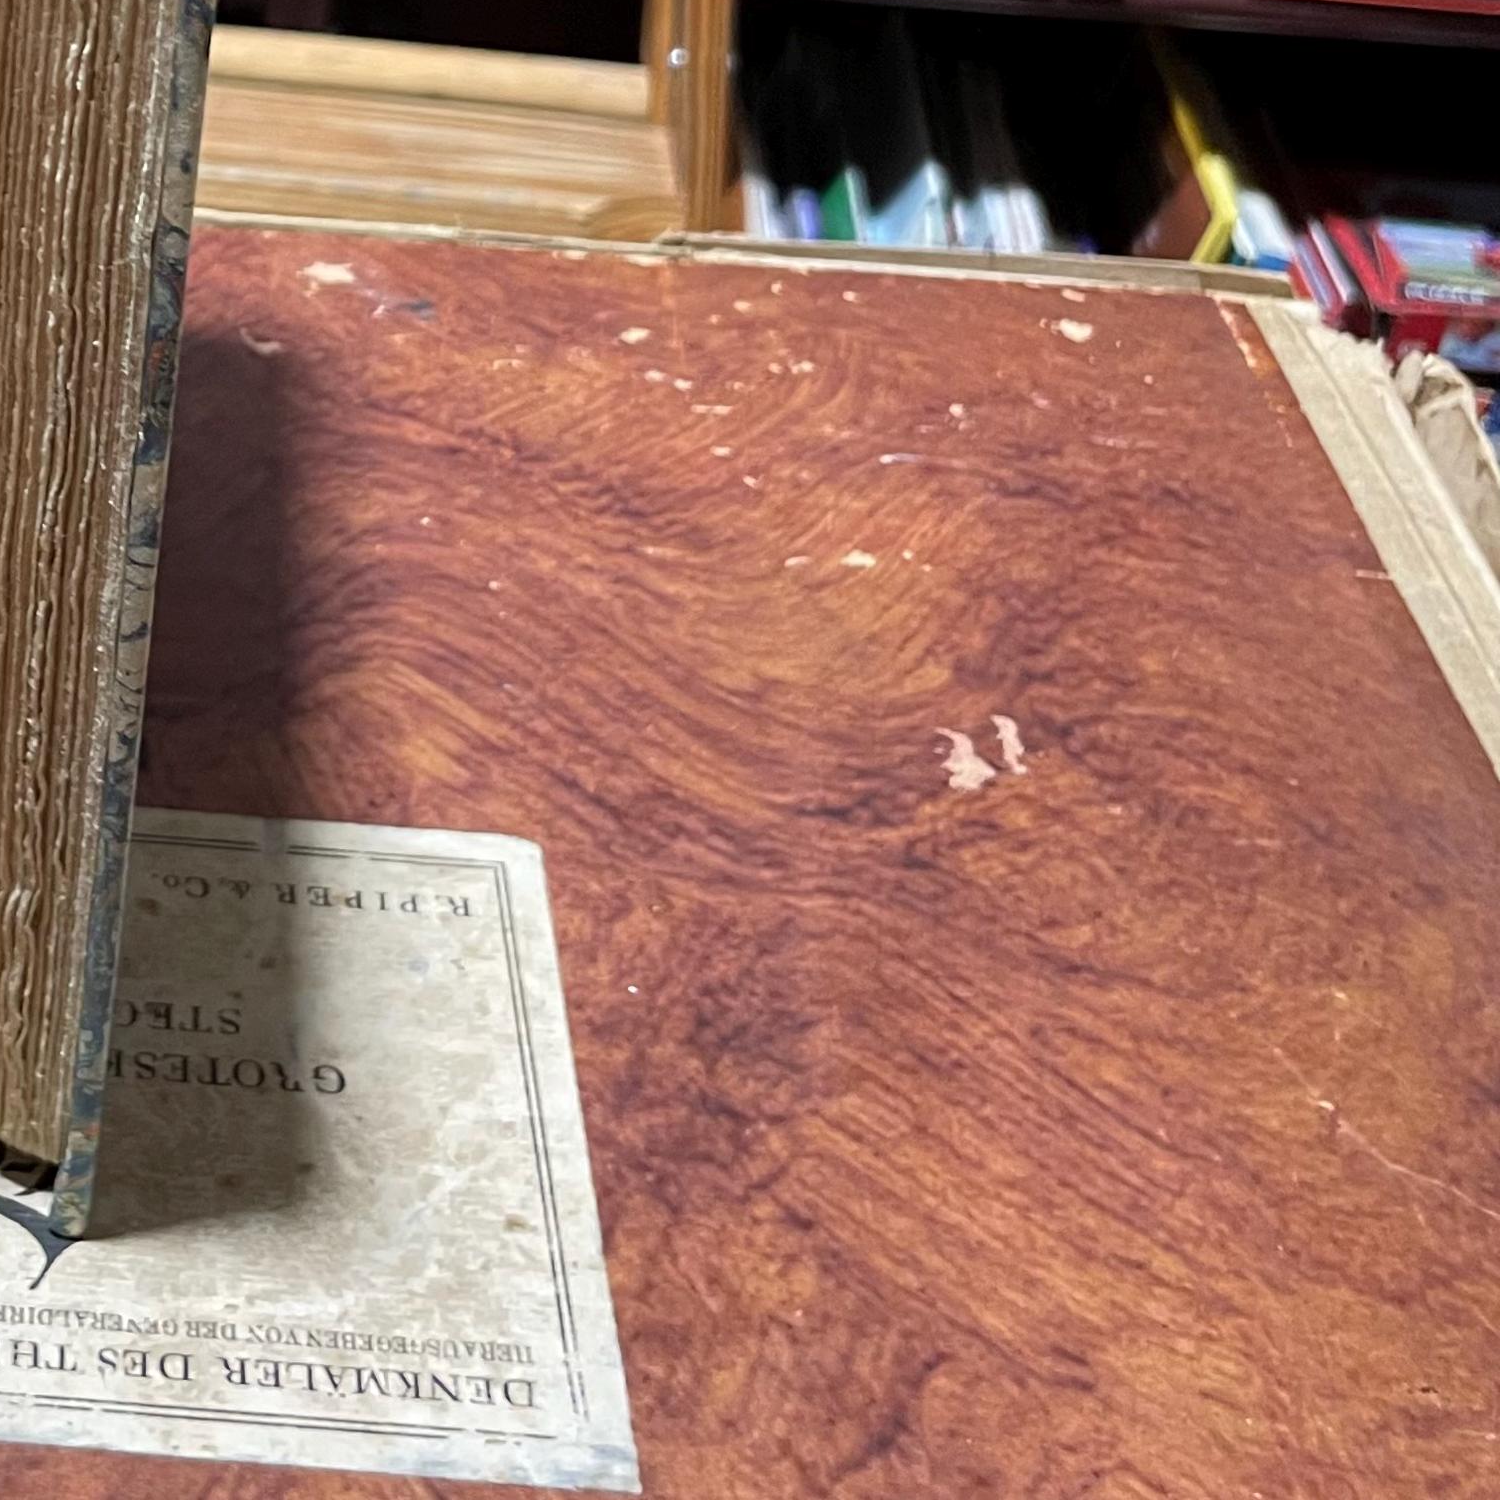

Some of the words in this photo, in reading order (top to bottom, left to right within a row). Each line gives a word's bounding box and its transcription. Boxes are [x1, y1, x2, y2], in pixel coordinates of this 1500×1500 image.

[270, 882, 419, 914] PIPER
[436, 894, 470, 916] R.
[183, 1320, 238, 1341] DER
[245, 1324, 303, 1346] VON
[97, 1347, 193, 1382] DES
[216, 1355, 539, 1409] DENKMÄLER
